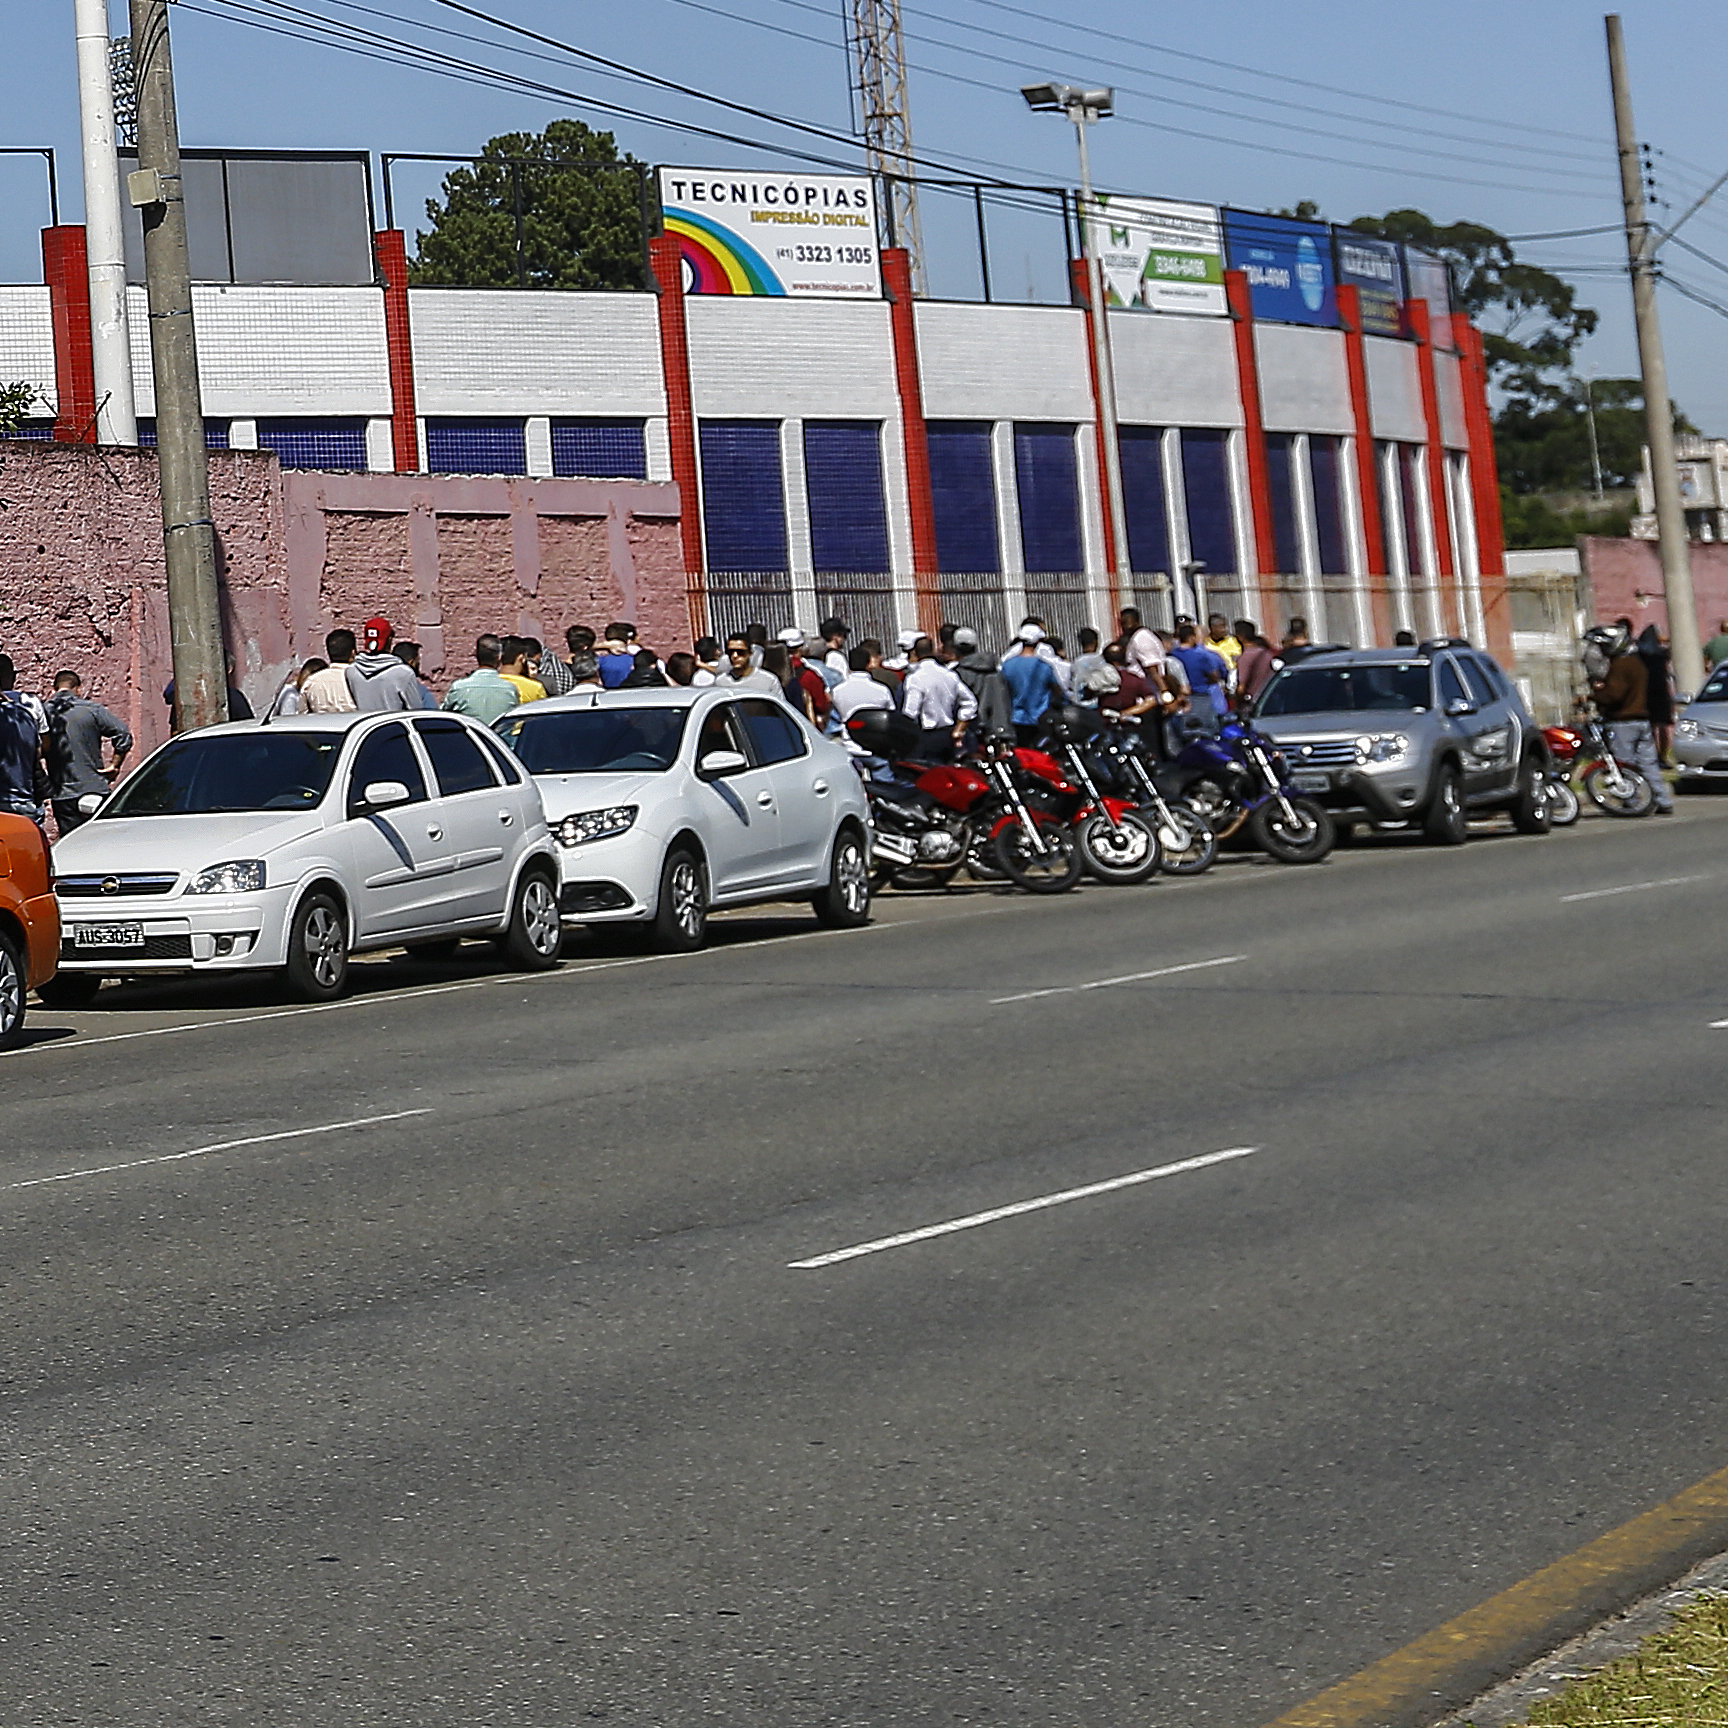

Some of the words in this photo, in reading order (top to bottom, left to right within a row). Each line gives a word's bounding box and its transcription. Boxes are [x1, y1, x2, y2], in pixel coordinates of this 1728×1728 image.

[671, 180, 868, 208] TECNICÓPIAS
[750, 209, 821, 226] IMPRESSÃO
[822, 213, 871, 228] DIGITAL
[796, 244, 833, 263] 3323
[836, 246, 873, 265] 1305
